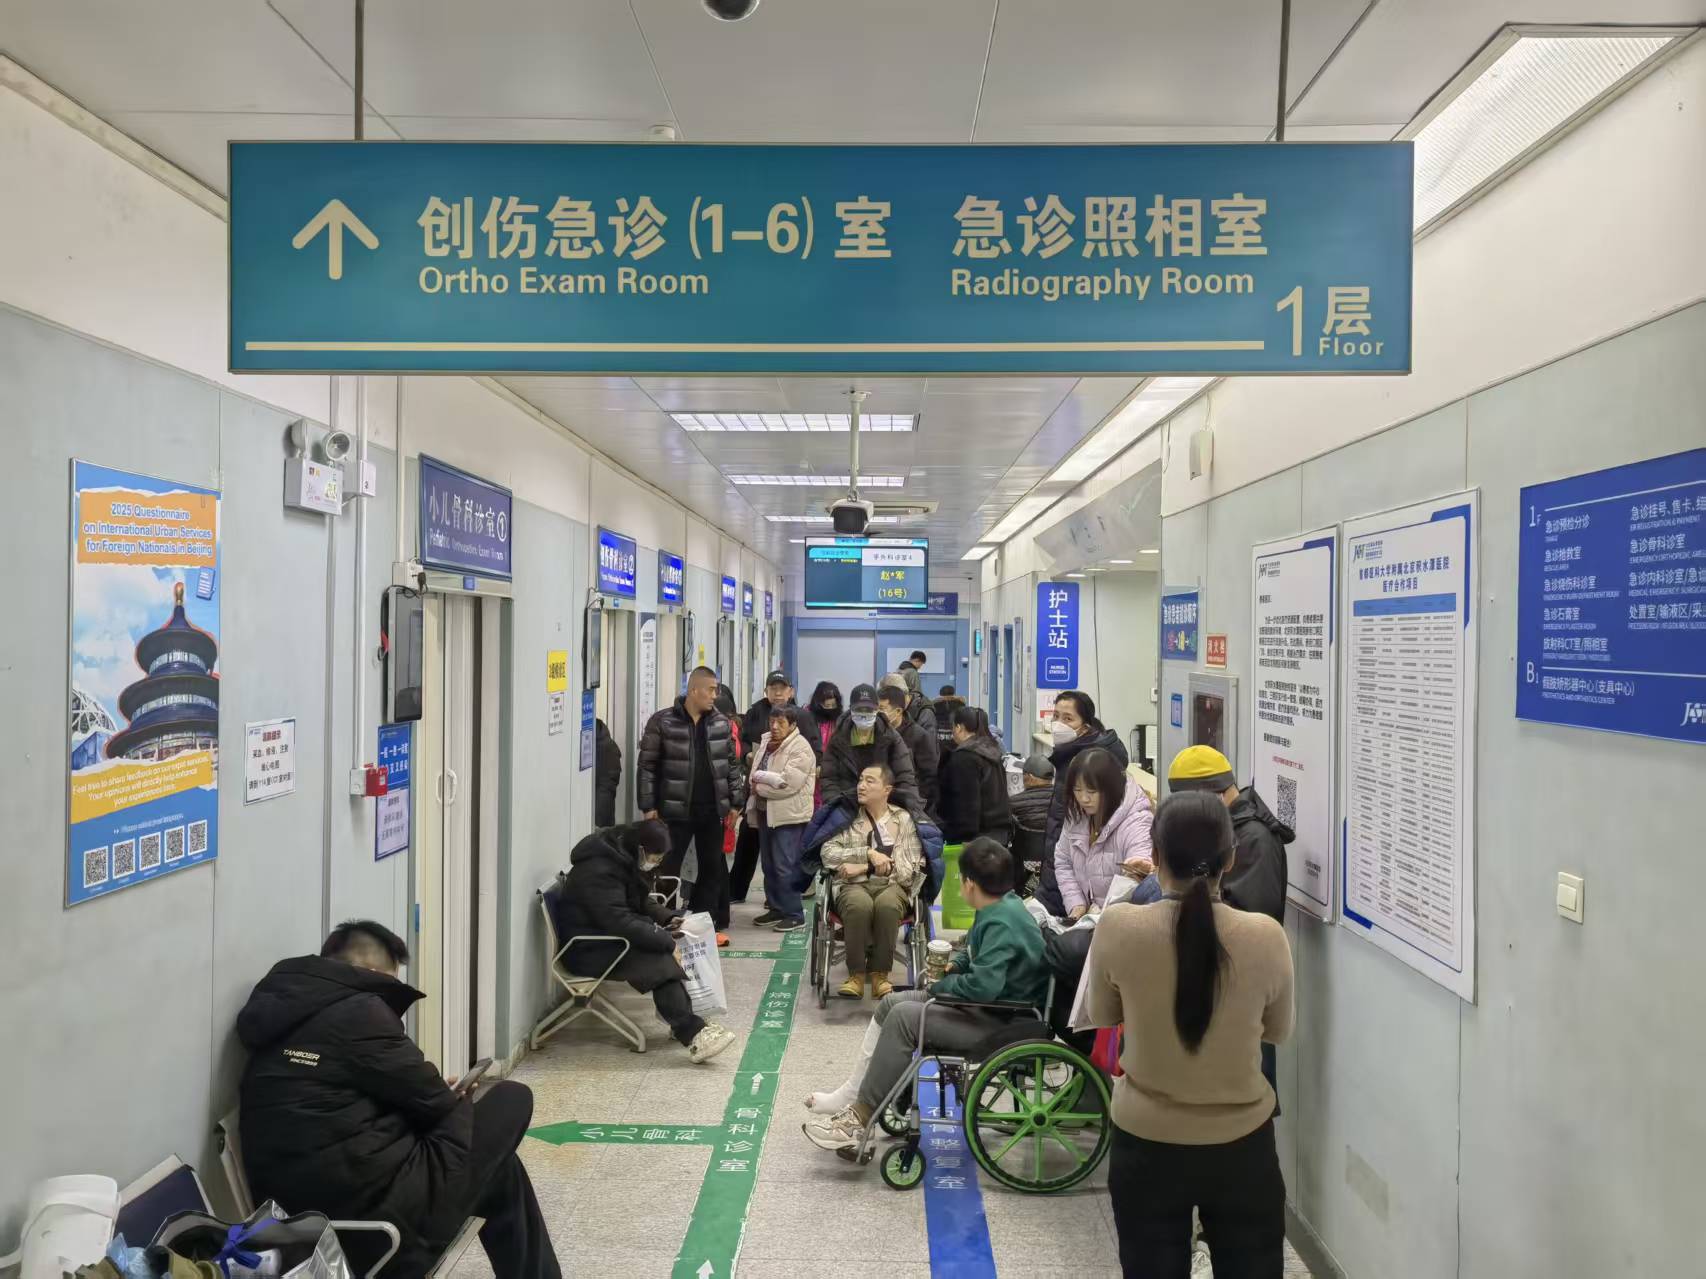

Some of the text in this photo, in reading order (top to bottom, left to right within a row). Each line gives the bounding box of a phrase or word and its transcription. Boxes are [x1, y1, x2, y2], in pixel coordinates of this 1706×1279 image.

[952, 193, 1268, 260] 急诊照相室
[419, 266, 1254, 301] Ortho Exam Room Radiography Room
[1318, 337, 1385, 357] Floor
[111, 503, 190, 520] 2025 Questionnaire
[84, 523, 211, 539] on International Urban Services
[87, 540, 212, 556] for Foreign Nationals in Beijing
[1630, 534, 1685, 553] 急诊骨科诊室
[878, 588, 907, 599] (16号)
[1048, 589, 1068, 648] 护士站
[579, 1127, 703, 1142] 小儿骨科
[715, 1106, 762, 1172] 骨科诊室
